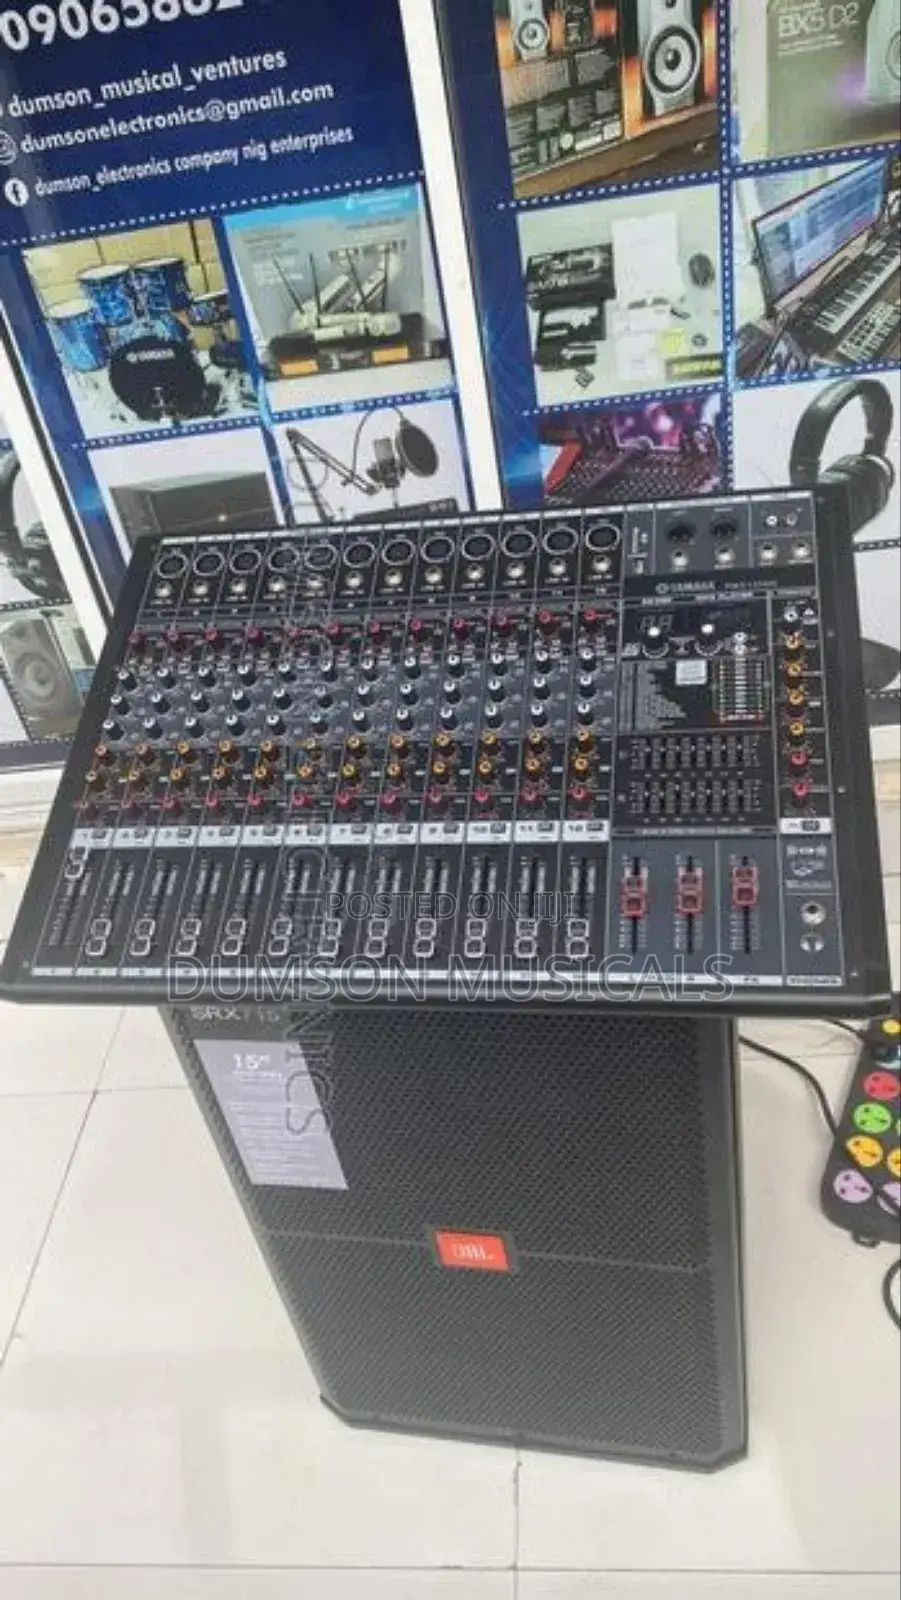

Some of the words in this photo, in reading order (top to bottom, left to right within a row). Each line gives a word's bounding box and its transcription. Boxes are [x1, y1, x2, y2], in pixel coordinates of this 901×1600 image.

[0, 0, 243, 50] 090658
[10, 50, 288, 118] dumson_musical_ventures
[21, 82, 334, 152] dumsonelectronics@gmail.com
[36, 157, 172, 196] dumson_electronics
[175, 150, 239, 172] company
[242, 139, 268, 161] nig
[270, 126, 354, 154] enterprises
